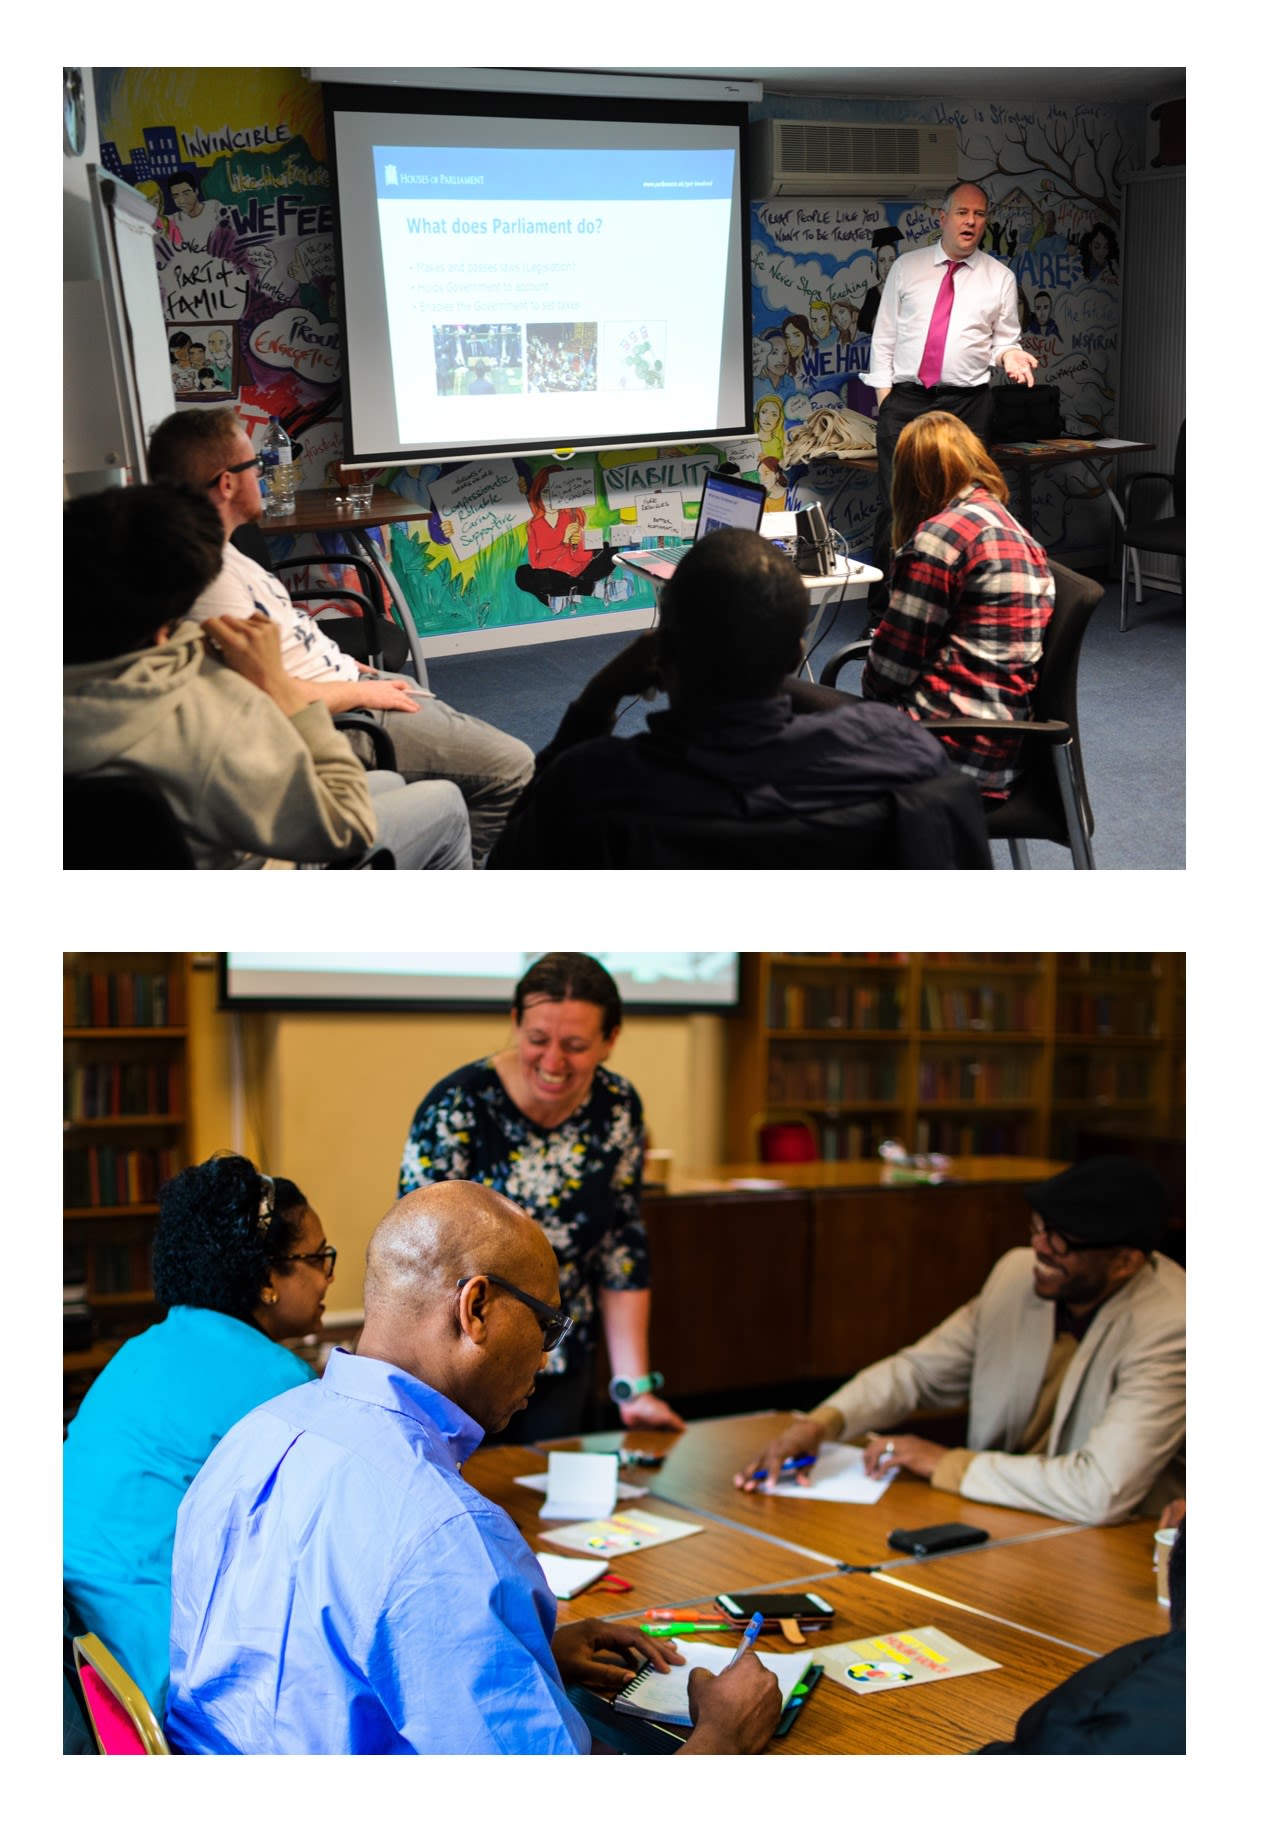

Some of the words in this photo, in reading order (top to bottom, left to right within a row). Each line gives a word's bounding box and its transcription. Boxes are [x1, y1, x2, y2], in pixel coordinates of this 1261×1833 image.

[181, 124, 292, 158] INVINCIBLE
[407, 217, 447, 234] What
[452, 217, 488, 234] does
[492, 217, 572, 234] Parliament
[577, 217, 603, 235] do?
[760, 209, 793, 225] TREAT
[796, 209, 831, 225] PEOPLE
[836, 209, 858, 223] LIKE
[862, 208, 880, 224] YOU
[774, 228, 800, 242] WANT
[816, 229, 830, 242] BE
[832, 226, 874, 241] TREATED
[173, 261, 214, 289] PART
[236, 267, 248, 276] a
[254, 274, 299, 304] Wanted
[769, 260, 794, 288] Never
[825, 279, 869, 302] Teaching
[166, 280, 249, 319] FAMILY
